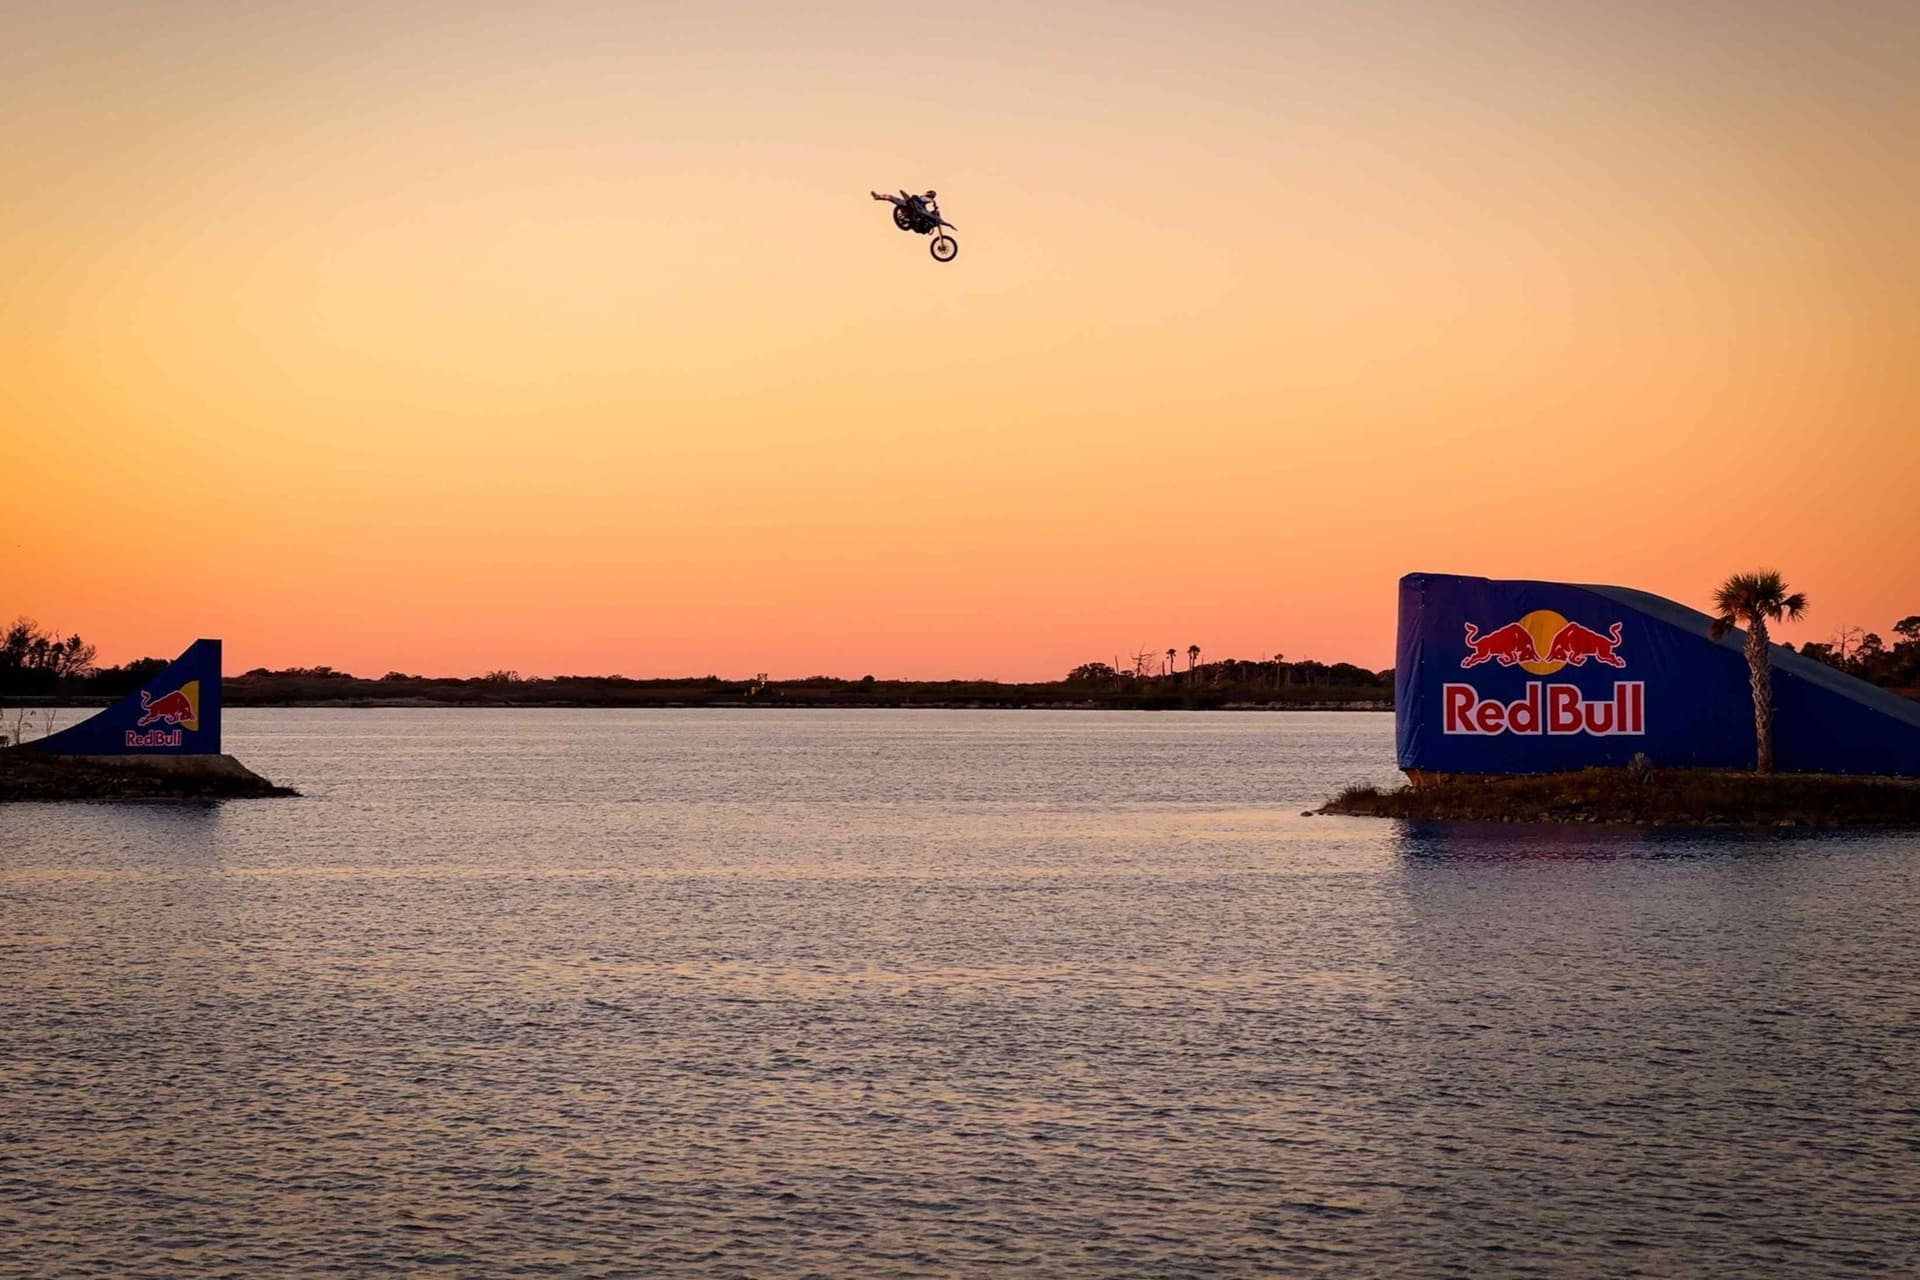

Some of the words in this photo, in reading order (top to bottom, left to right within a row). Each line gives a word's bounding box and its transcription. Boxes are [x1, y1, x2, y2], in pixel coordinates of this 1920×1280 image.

[1443, 681, 1542, 735] Red
[1547, 681, 1645, 736] Bull
[126, 730, 153, 746] Red
[154, 730, 181, 746] Bull
